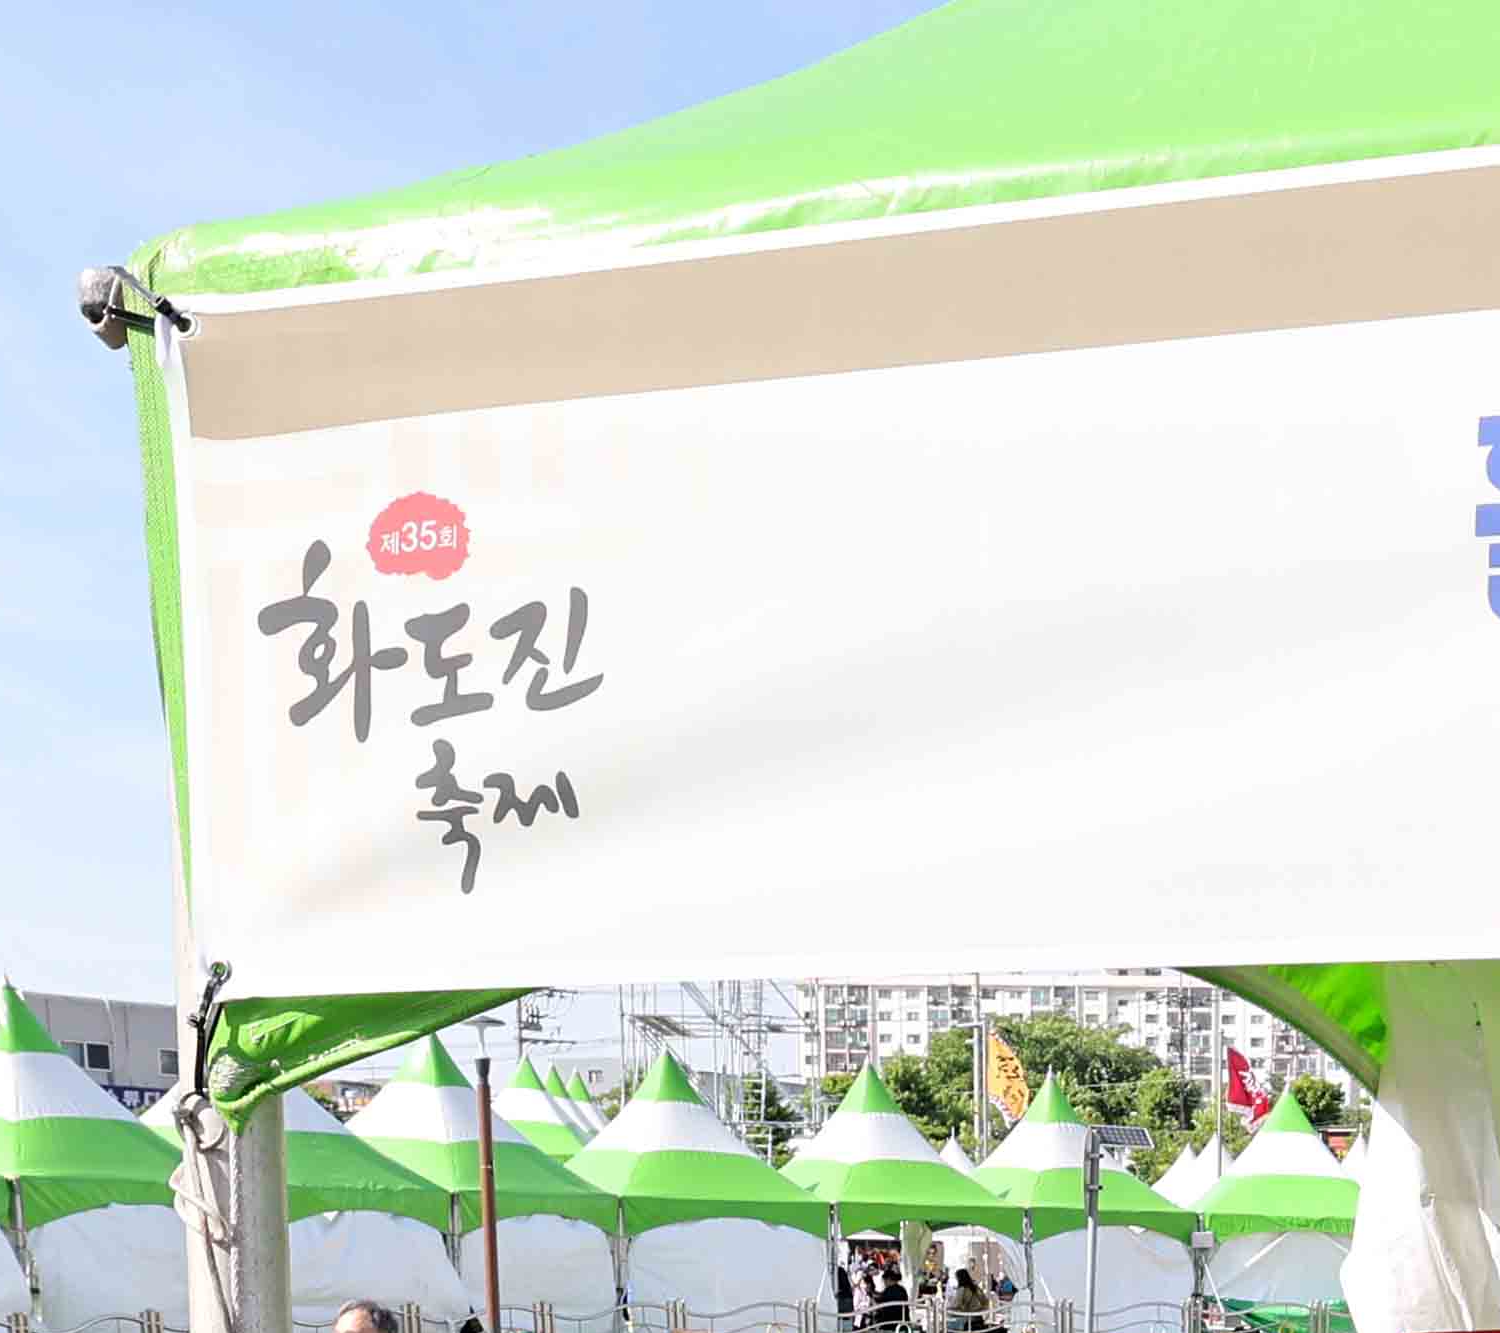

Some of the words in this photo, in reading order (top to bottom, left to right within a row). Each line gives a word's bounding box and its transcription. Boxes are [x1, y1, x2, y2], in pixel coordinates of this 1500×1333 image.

[380, 519, 458, 555] 제35회
[257, 539, 605, 743] 화도진
[415, 738, 580, 894] 축제
